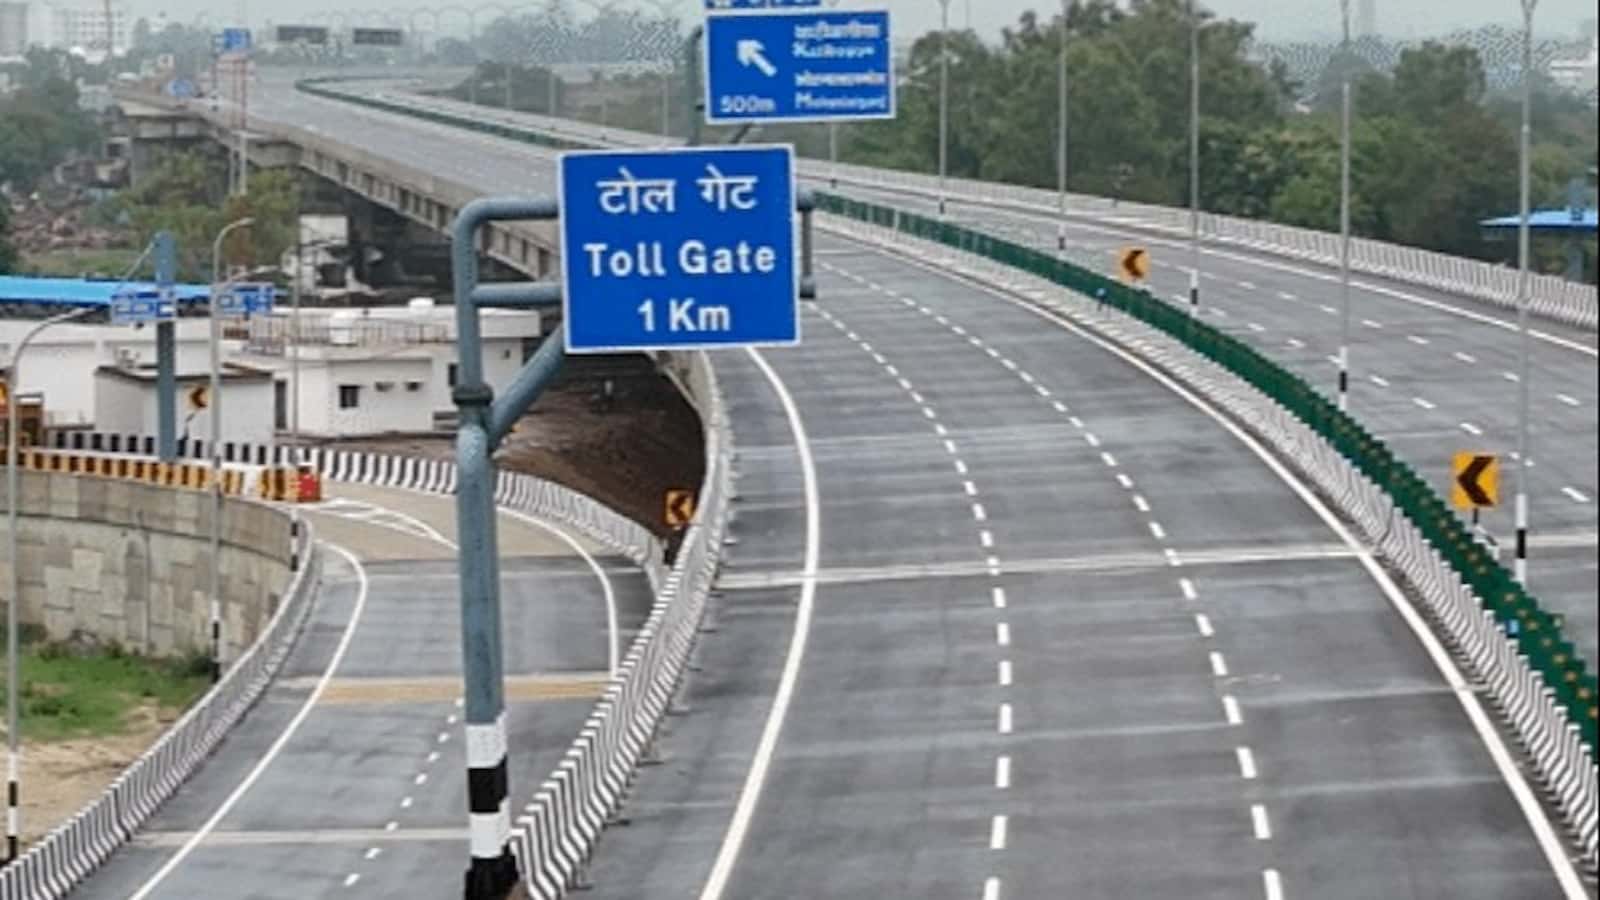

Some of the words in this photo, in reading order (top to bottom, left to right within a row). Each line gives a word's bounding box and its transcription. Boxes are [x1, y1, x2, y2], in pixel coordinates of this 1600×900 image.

[720, 95, 775, 113] 500m
[596, 167, 676, 214] टोल
[697, 163, 758, 212] गेट
[583, 241, 666, 277] Toll
[679, 239, 776, 275] Gate
[638, 299, 654, 332] 1
[669, 298, 731, 332] Km
